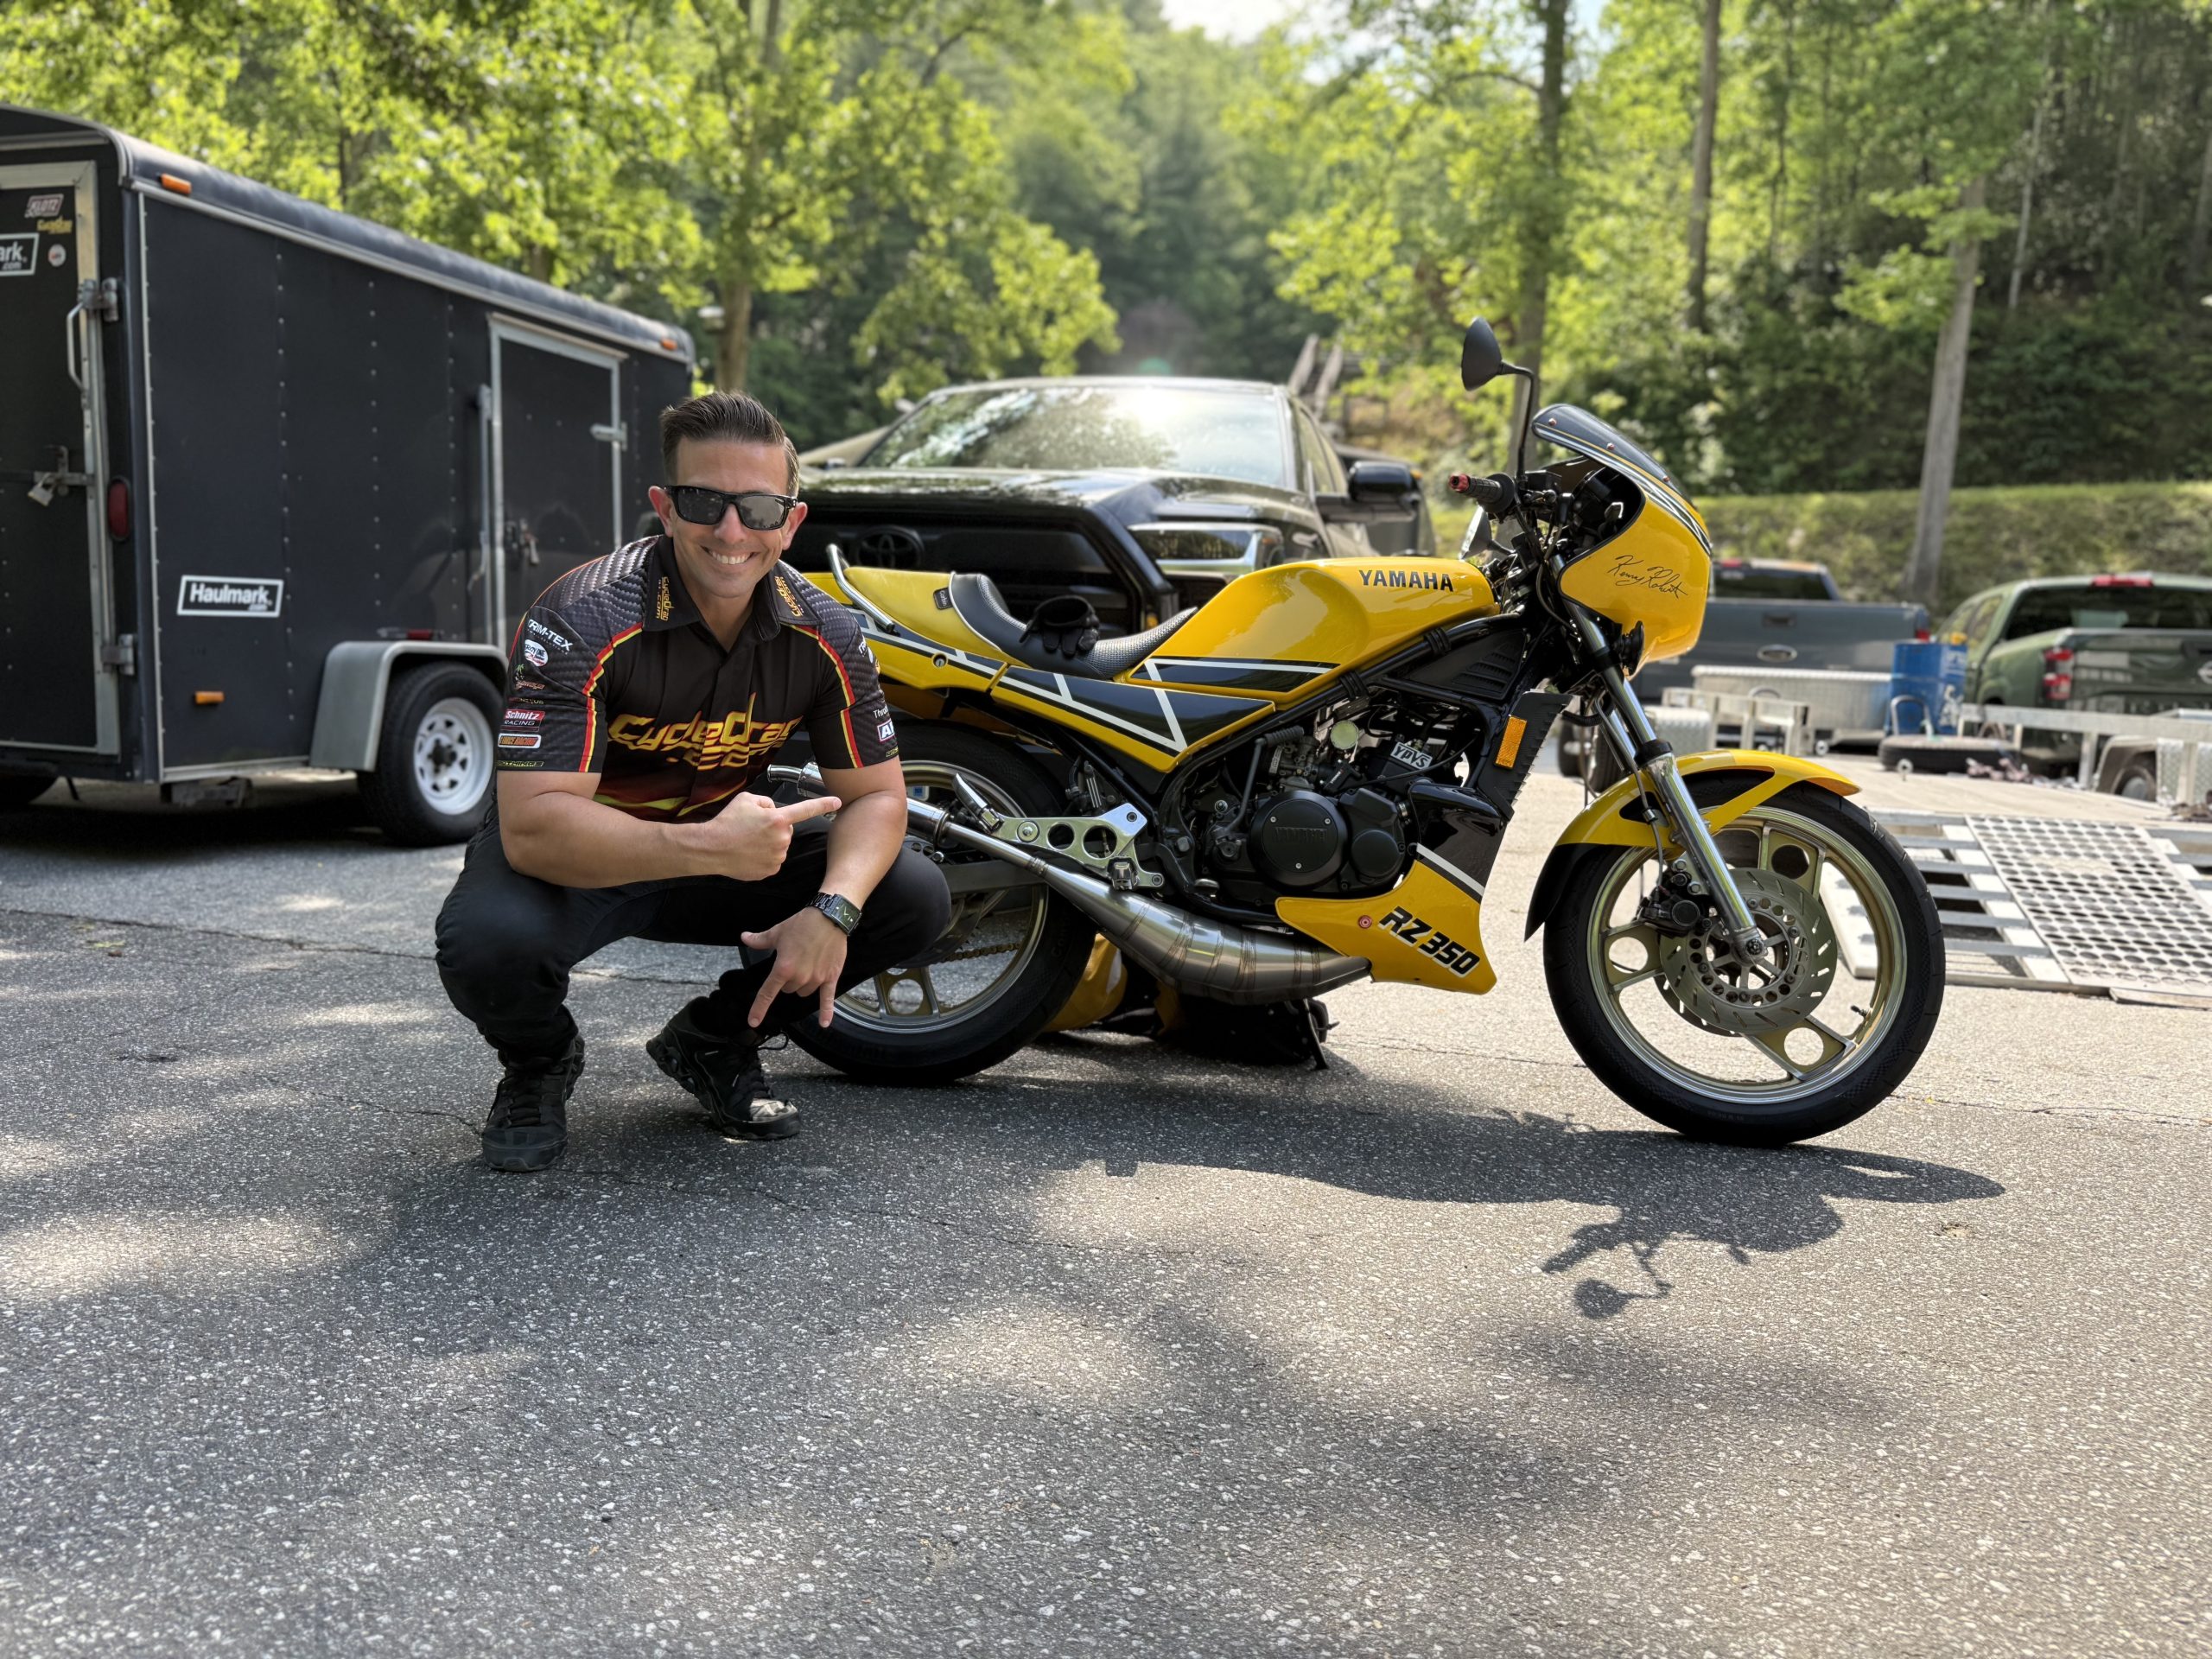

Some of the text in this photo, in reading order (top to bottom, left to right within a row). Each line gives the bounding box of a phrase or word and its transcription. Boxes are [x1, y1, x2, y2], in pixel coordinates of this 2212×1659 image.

[1359, 569, 1454, 592] YAMAHA
[190, 582, 269, 604] Haulmark
[505, 710, 540, 720] Schnitz
[1378, 906, 1481, 978] RZ 350
